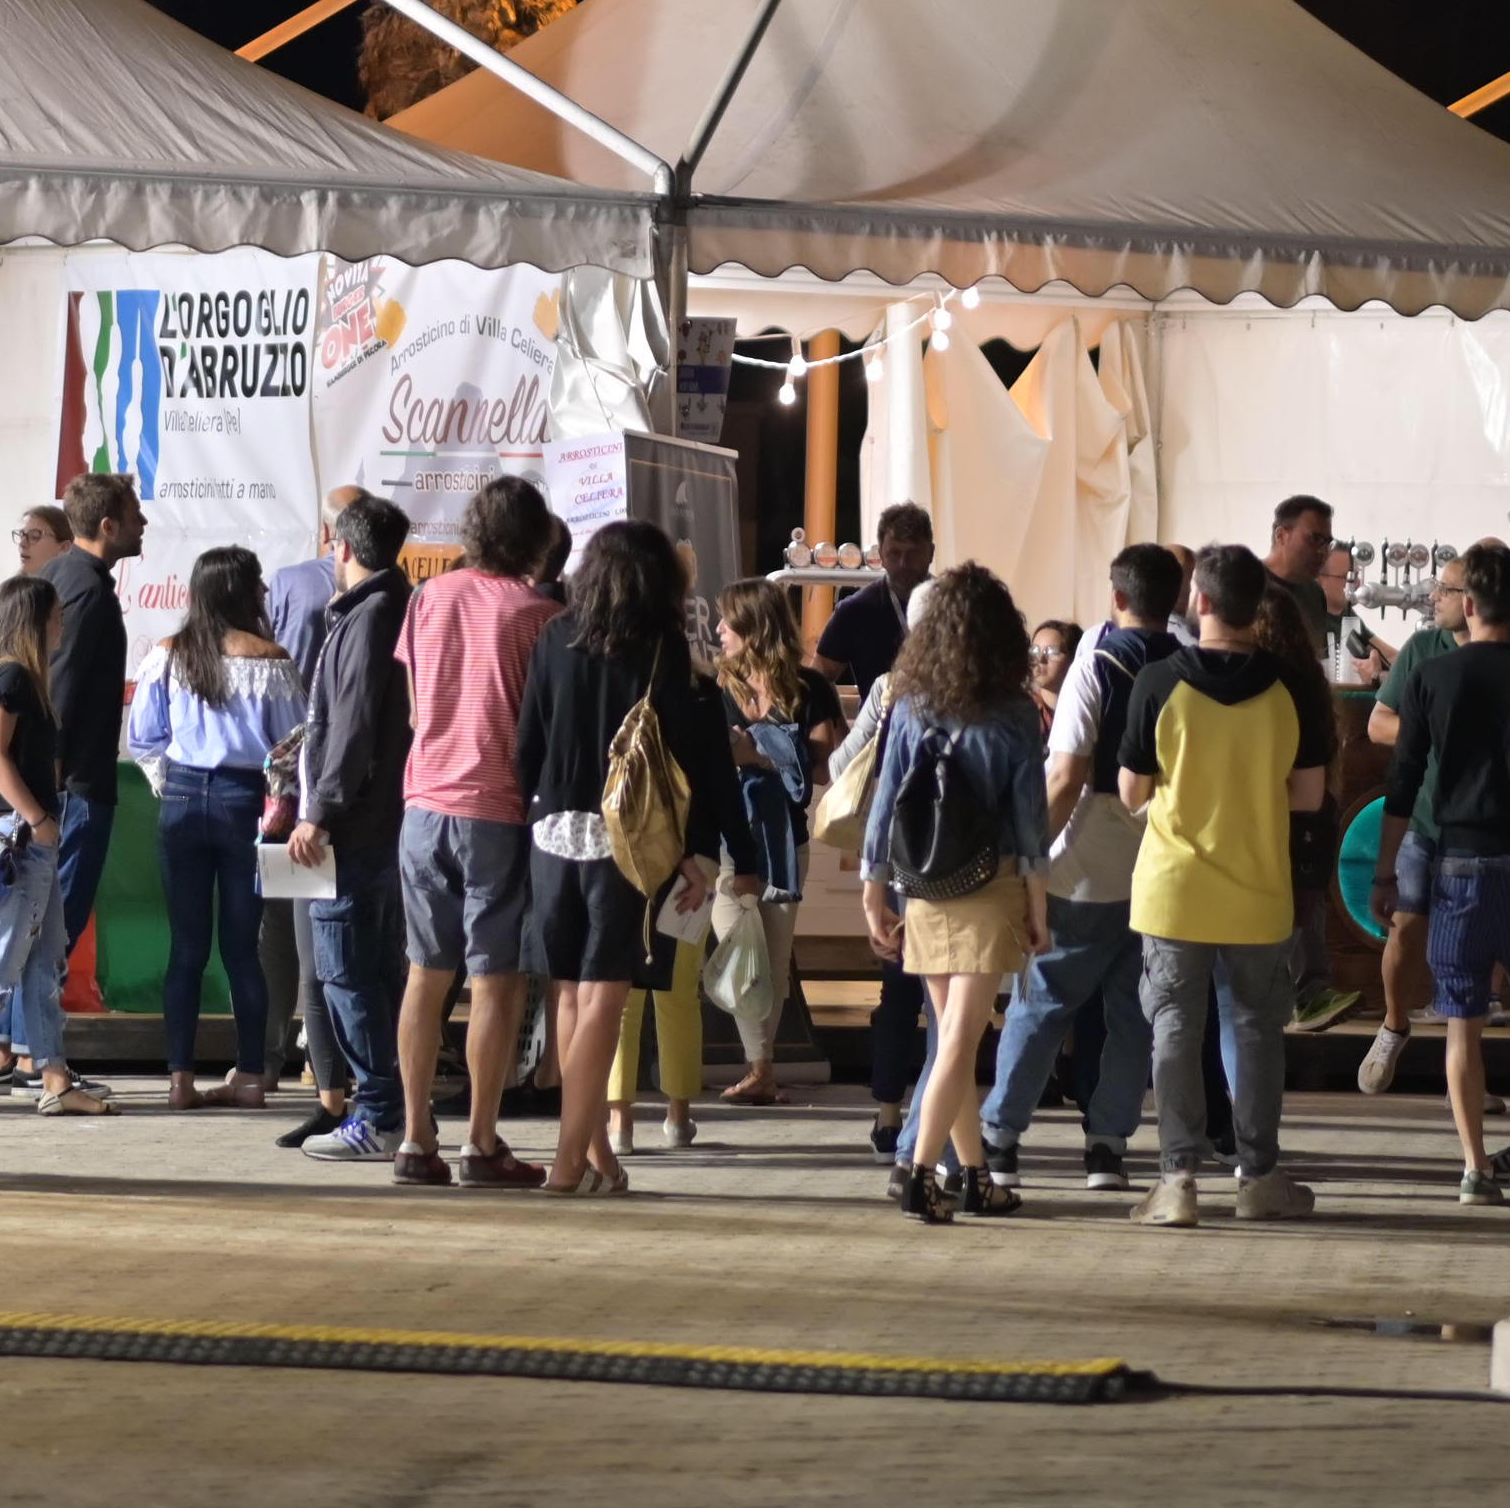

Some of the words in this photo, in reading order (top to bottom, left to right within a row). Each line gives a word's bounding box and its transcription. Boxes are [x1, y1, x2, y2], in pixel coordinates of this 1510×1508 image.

[321, 297, 376, 369] ONE
[391, 317, 456, 376] Arrosticino
[460, 315, 471, 334] di
[475, 315, 507, 342] Villa
[510, 328, 555, 376] Celiera
[382, 373, 554, 445] Scannella
[574, 486, 624, 506] CELIERA
[579, 472, 613, 486] VILLA
